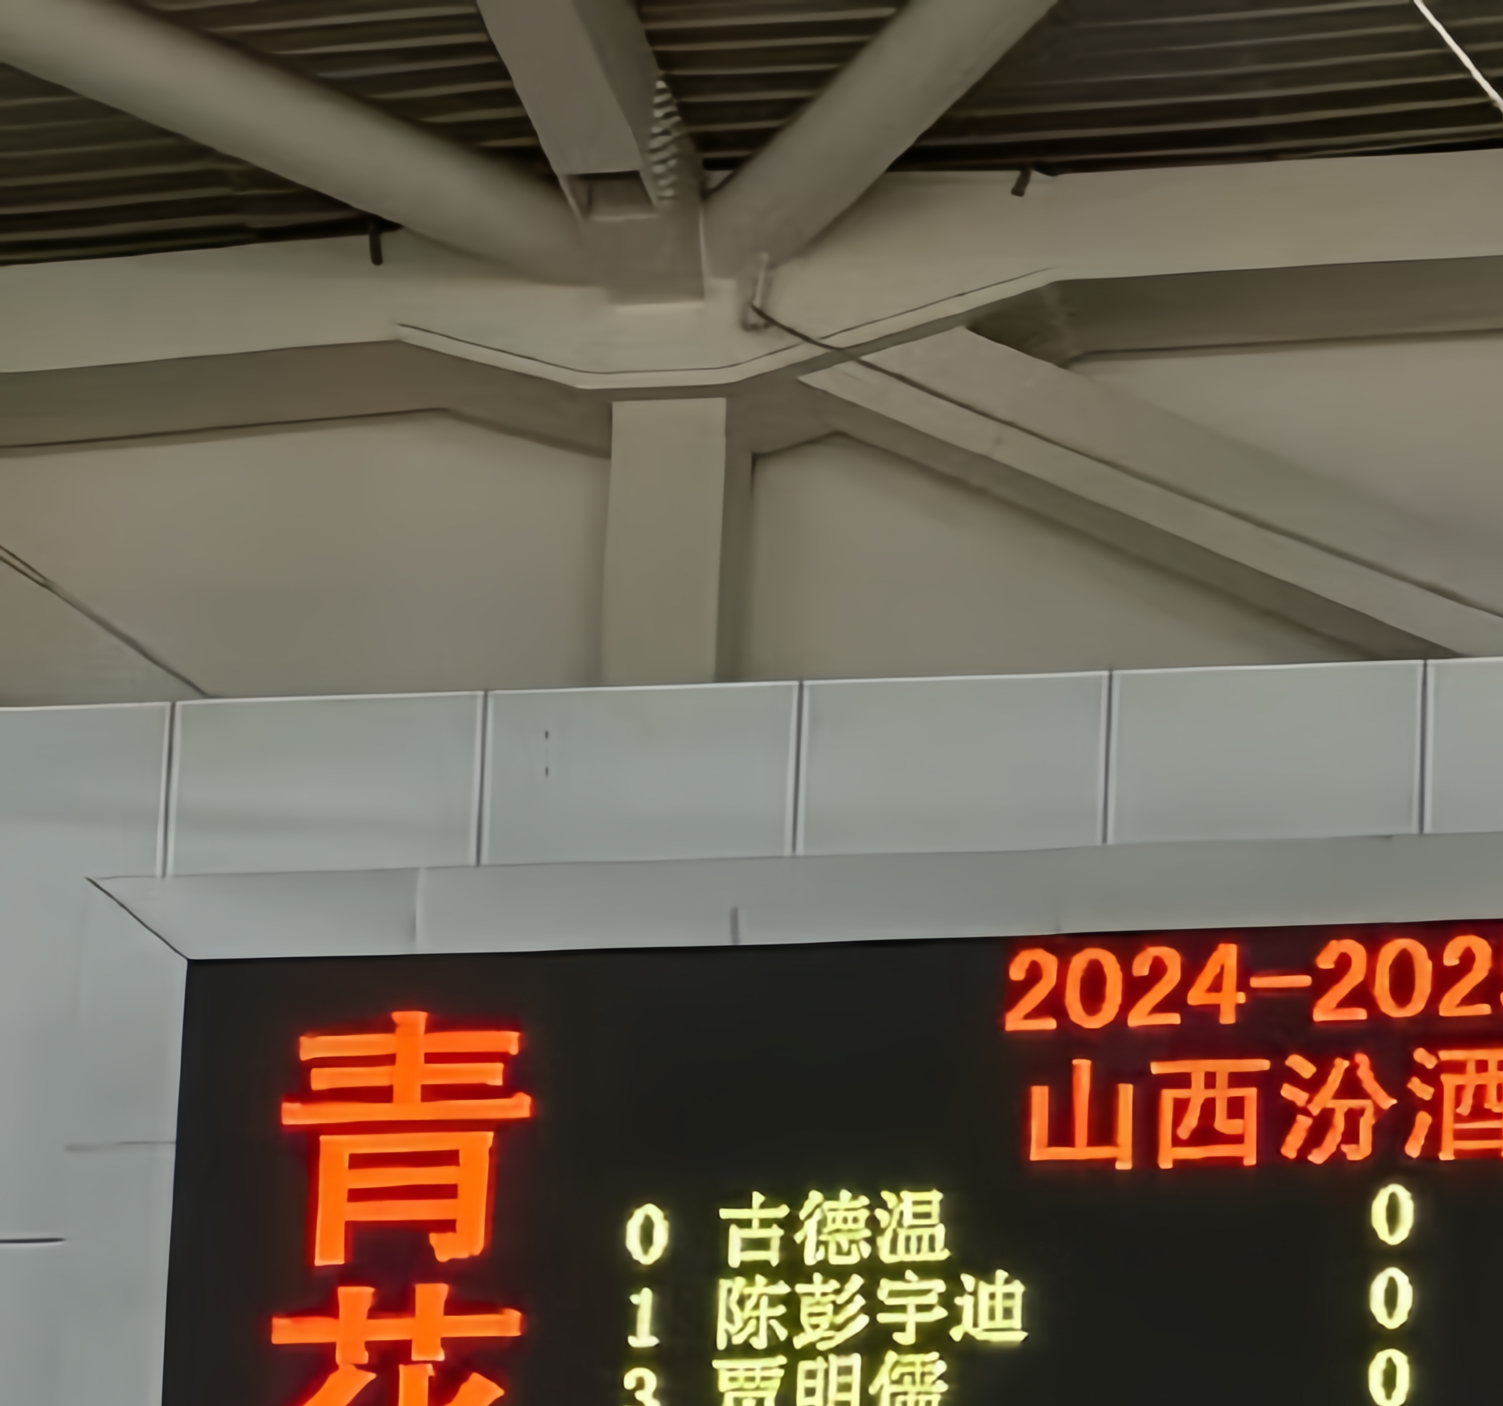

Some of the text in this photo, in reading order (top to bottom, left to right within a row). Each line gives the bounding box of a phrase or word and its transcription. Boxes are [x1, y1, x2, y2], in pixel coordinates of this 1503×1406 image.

[626, 1189, 950, 1268] 0 古德温
[1371, 1184, 1415, 1245] 0
[628, 1269, 1028, 1351] 1 陈彭宇迪
[1370, 1267, 1413, 1329] 0
